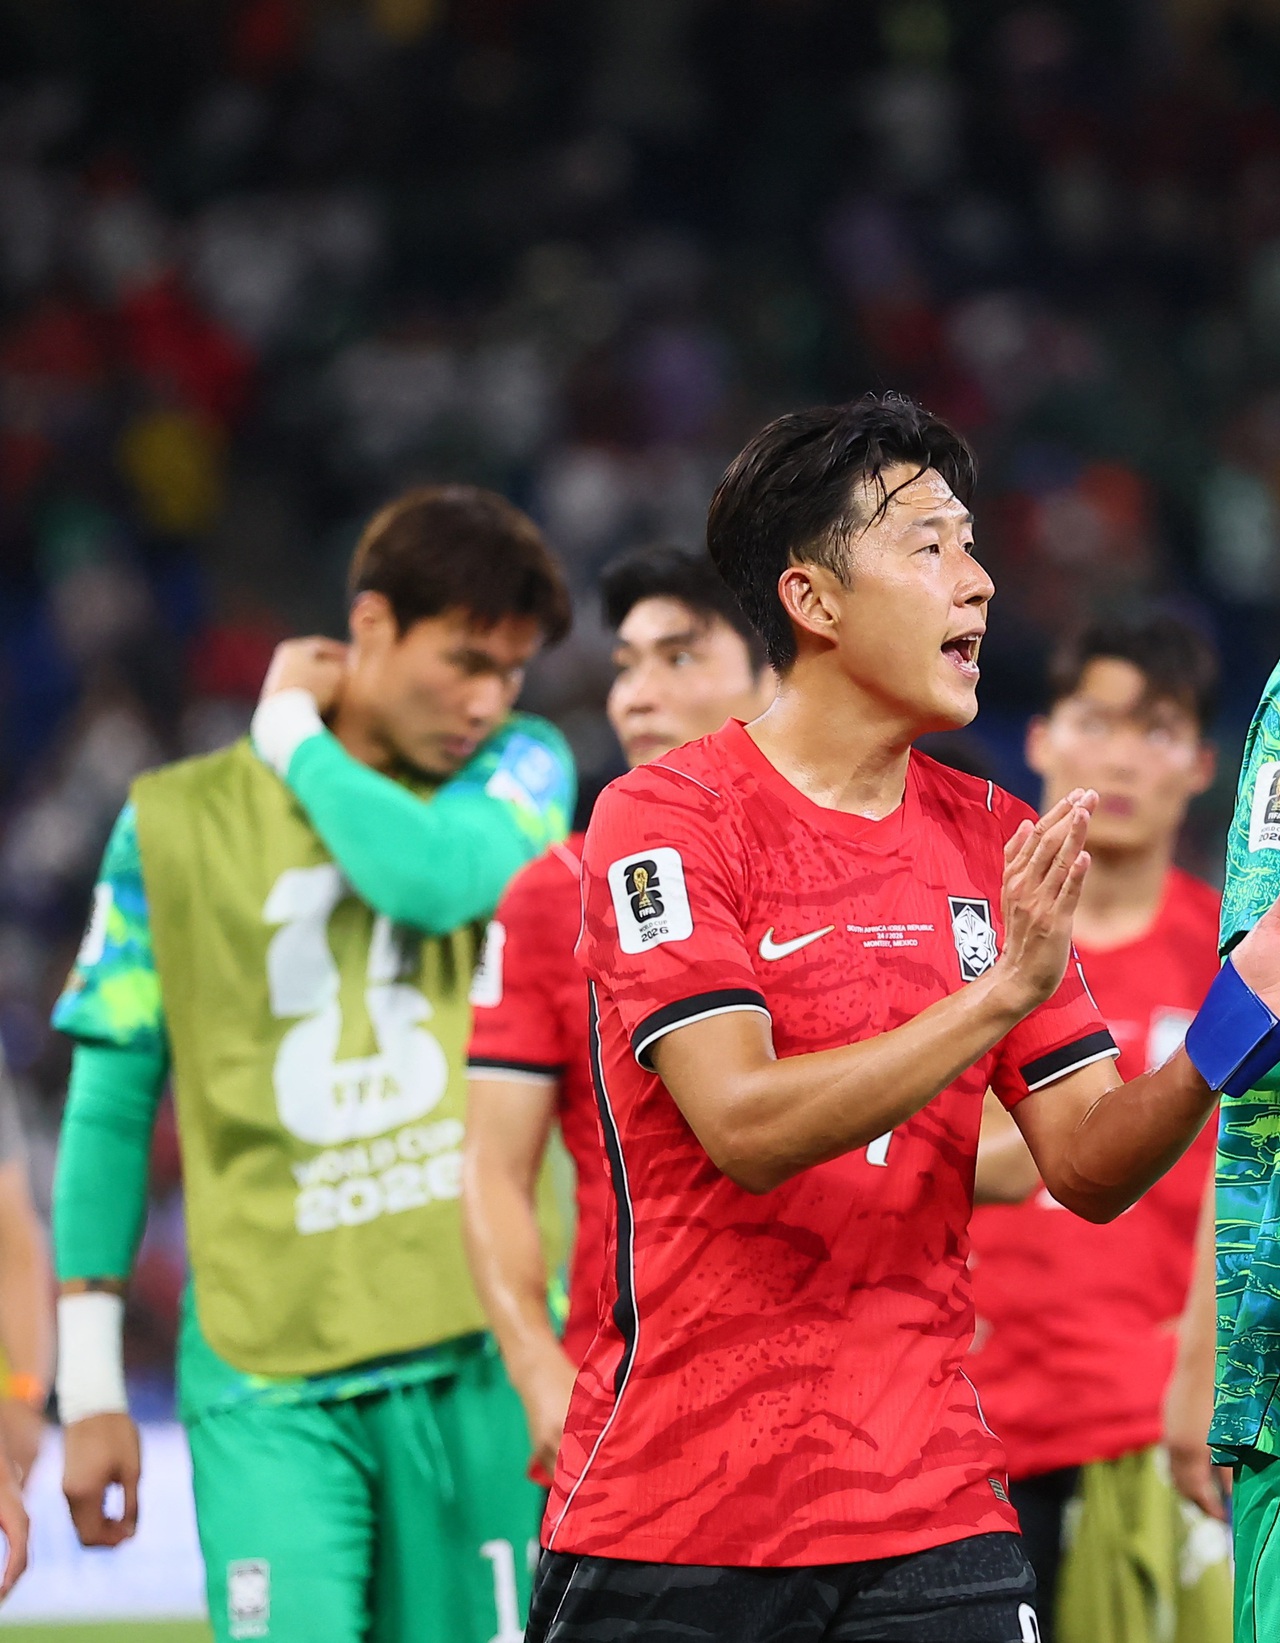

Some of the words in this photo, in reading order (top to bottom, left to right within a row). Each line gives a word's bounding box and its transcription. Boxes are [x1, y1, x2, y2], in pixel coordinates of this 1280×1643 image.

[639, 906, 657, 918] FIFA
[641, 926, 669, 942] 2026
[295, 1152, 463, 1235] 2026
